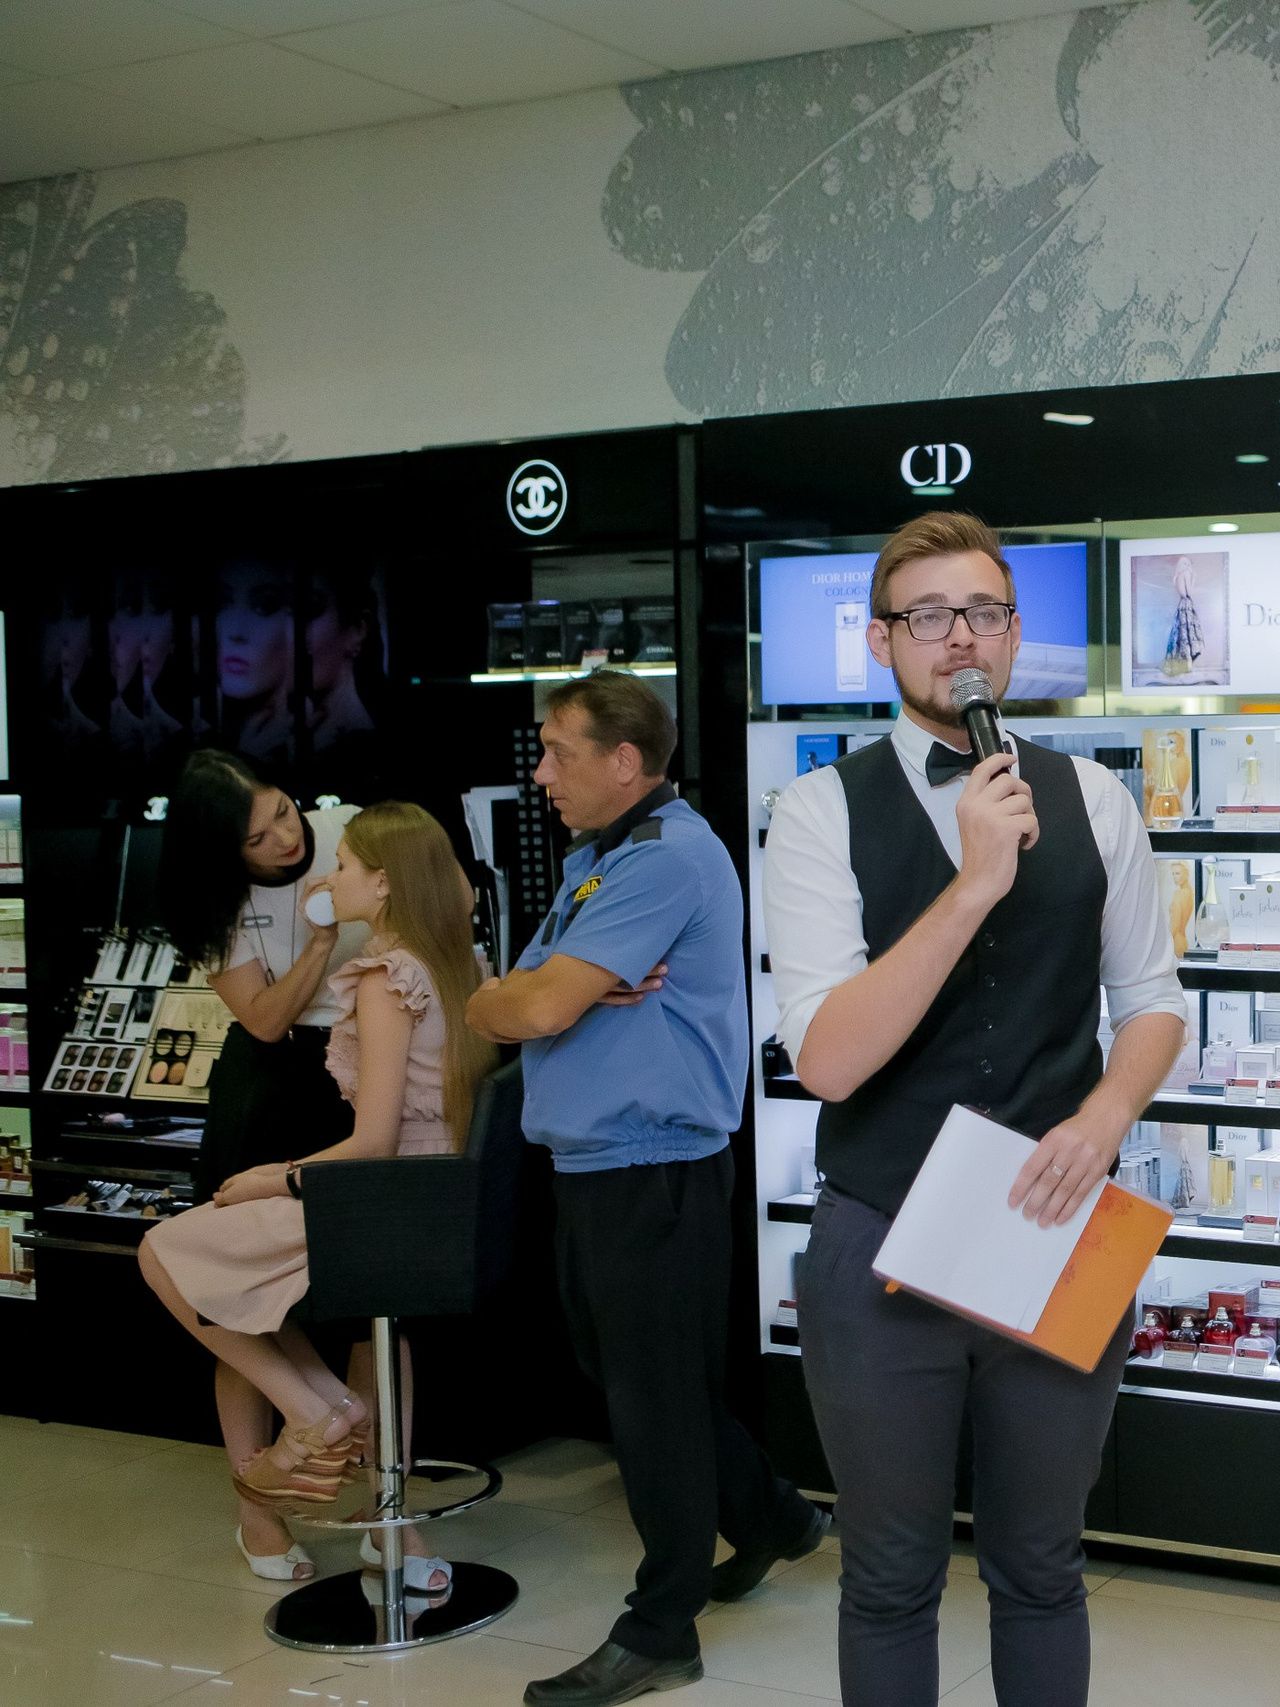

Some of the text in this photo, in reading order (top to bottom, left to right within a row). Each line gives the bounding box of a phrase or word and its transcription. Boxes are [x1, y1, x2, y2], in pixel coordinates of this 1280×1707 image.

[811, 571, 871, 585] DIOR HOM
[825, 586, 870, 597] COLOGN
[1210, 737, 1226, 746] Dio
[1219, 1001, 1239, 1011] Dior
[1228, 1131, 1248, 1141] Dior
